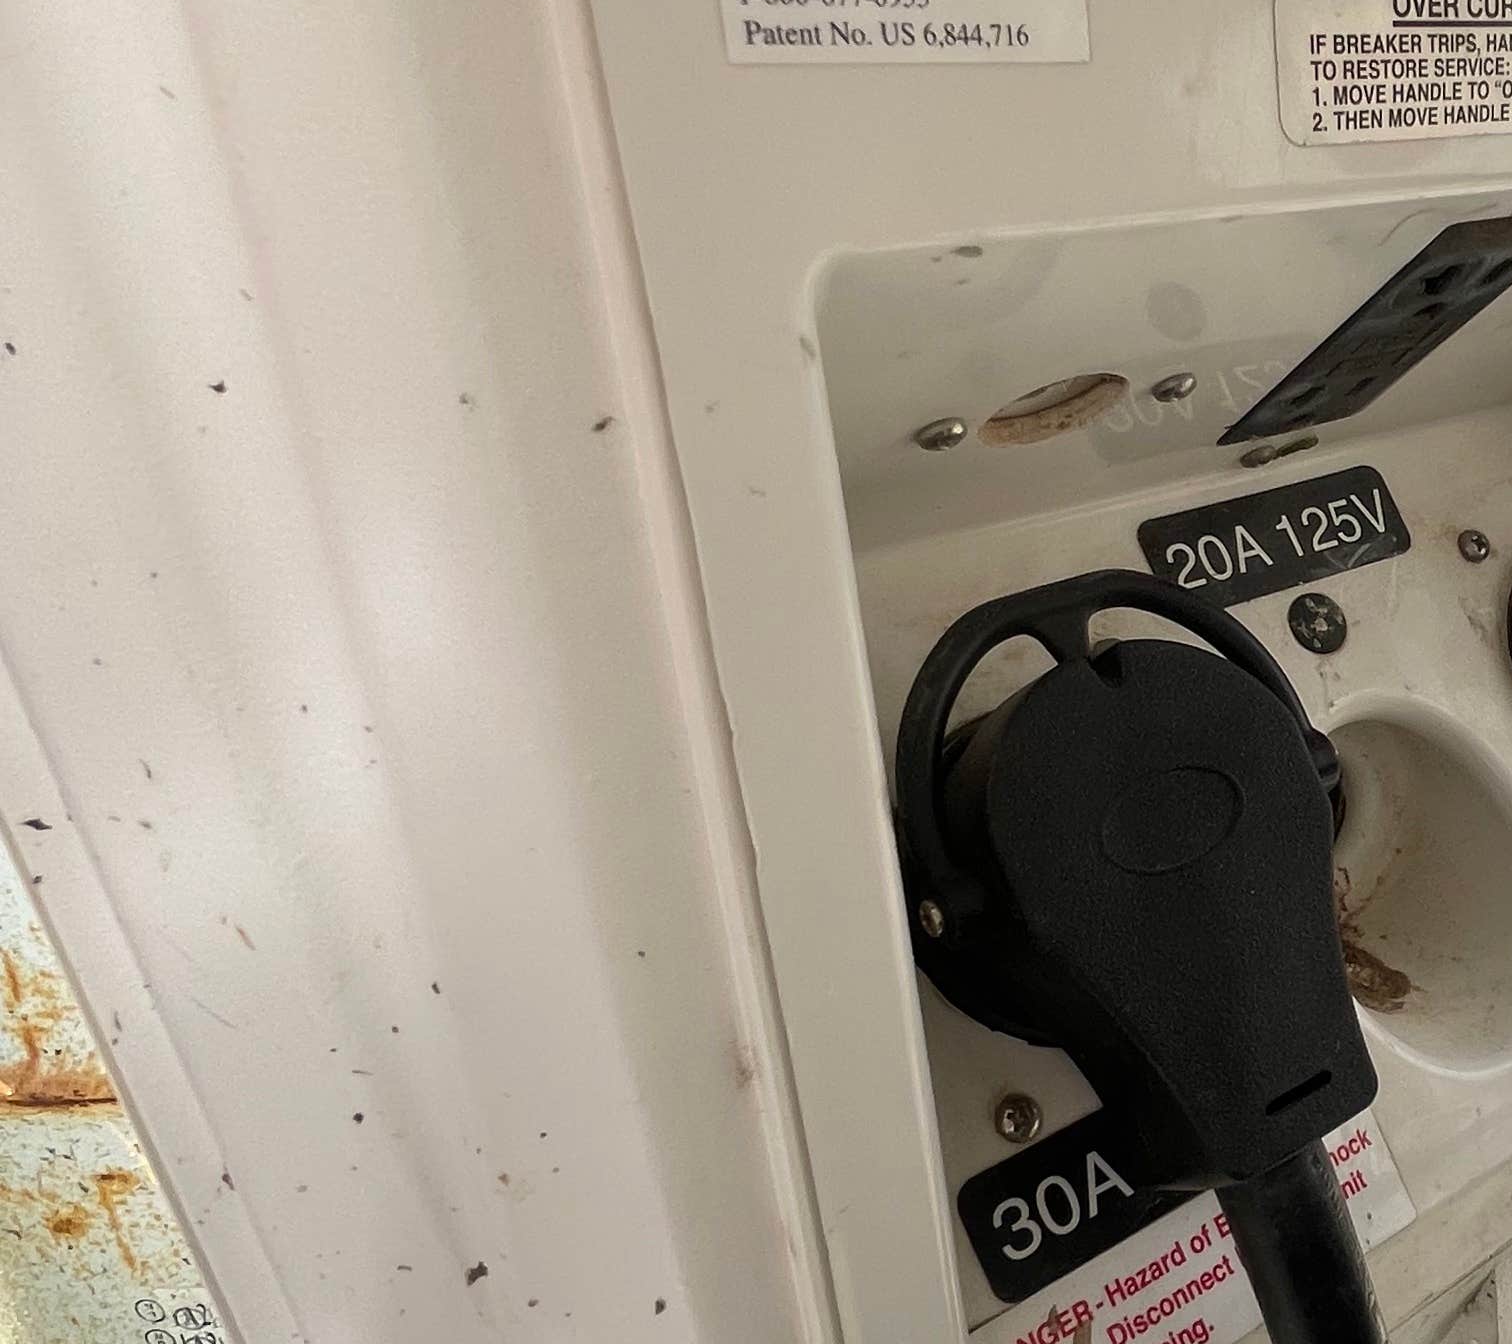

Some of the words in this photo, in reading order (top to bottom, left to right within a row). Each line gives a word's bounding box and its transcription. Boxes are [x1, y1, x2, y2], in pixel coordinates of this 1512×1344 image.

[744, 20, 822, 46] Patent
[830, 21, 872, 46] No.
[881, 22, 916, 47] US
[922, 23, 1030, 49] 6,844,716
[1309, 34, 1327, 55] IF
[1333, 34, 1422, 55] BREAKER
[1427, 33, 1482, 57] TRIPS,
[1310, 60, 1337, 81] TO
[1343, 58, 1429, 80] RESTORE
[1434, 57, 1511, 77] SERVICE:
[1312, 86, 1328, 107] 1.
[1333, 84, 1387, 106] MOVE
[1392, 82, 1463, 103] HANDLE
[1467, 80, 1490, 100] TO
[1312, 112, 1328, 132] 2.
[1333, 109, 1383, 131] THEN
[1388, 107, 1438, 128] MOVE
[1444, 104, 1510, 124] HANDLE
[1166, 524, 1274, 589] 20A
[1275, 488, 1386, 557] 125V
[1341, 1168, 1368, 1200] nit
[992, 1150, 1134, 1261] 30A
[1104, 1241, 1187, 1307] Hazard
[1190, 1223, 1213, 1254] of
